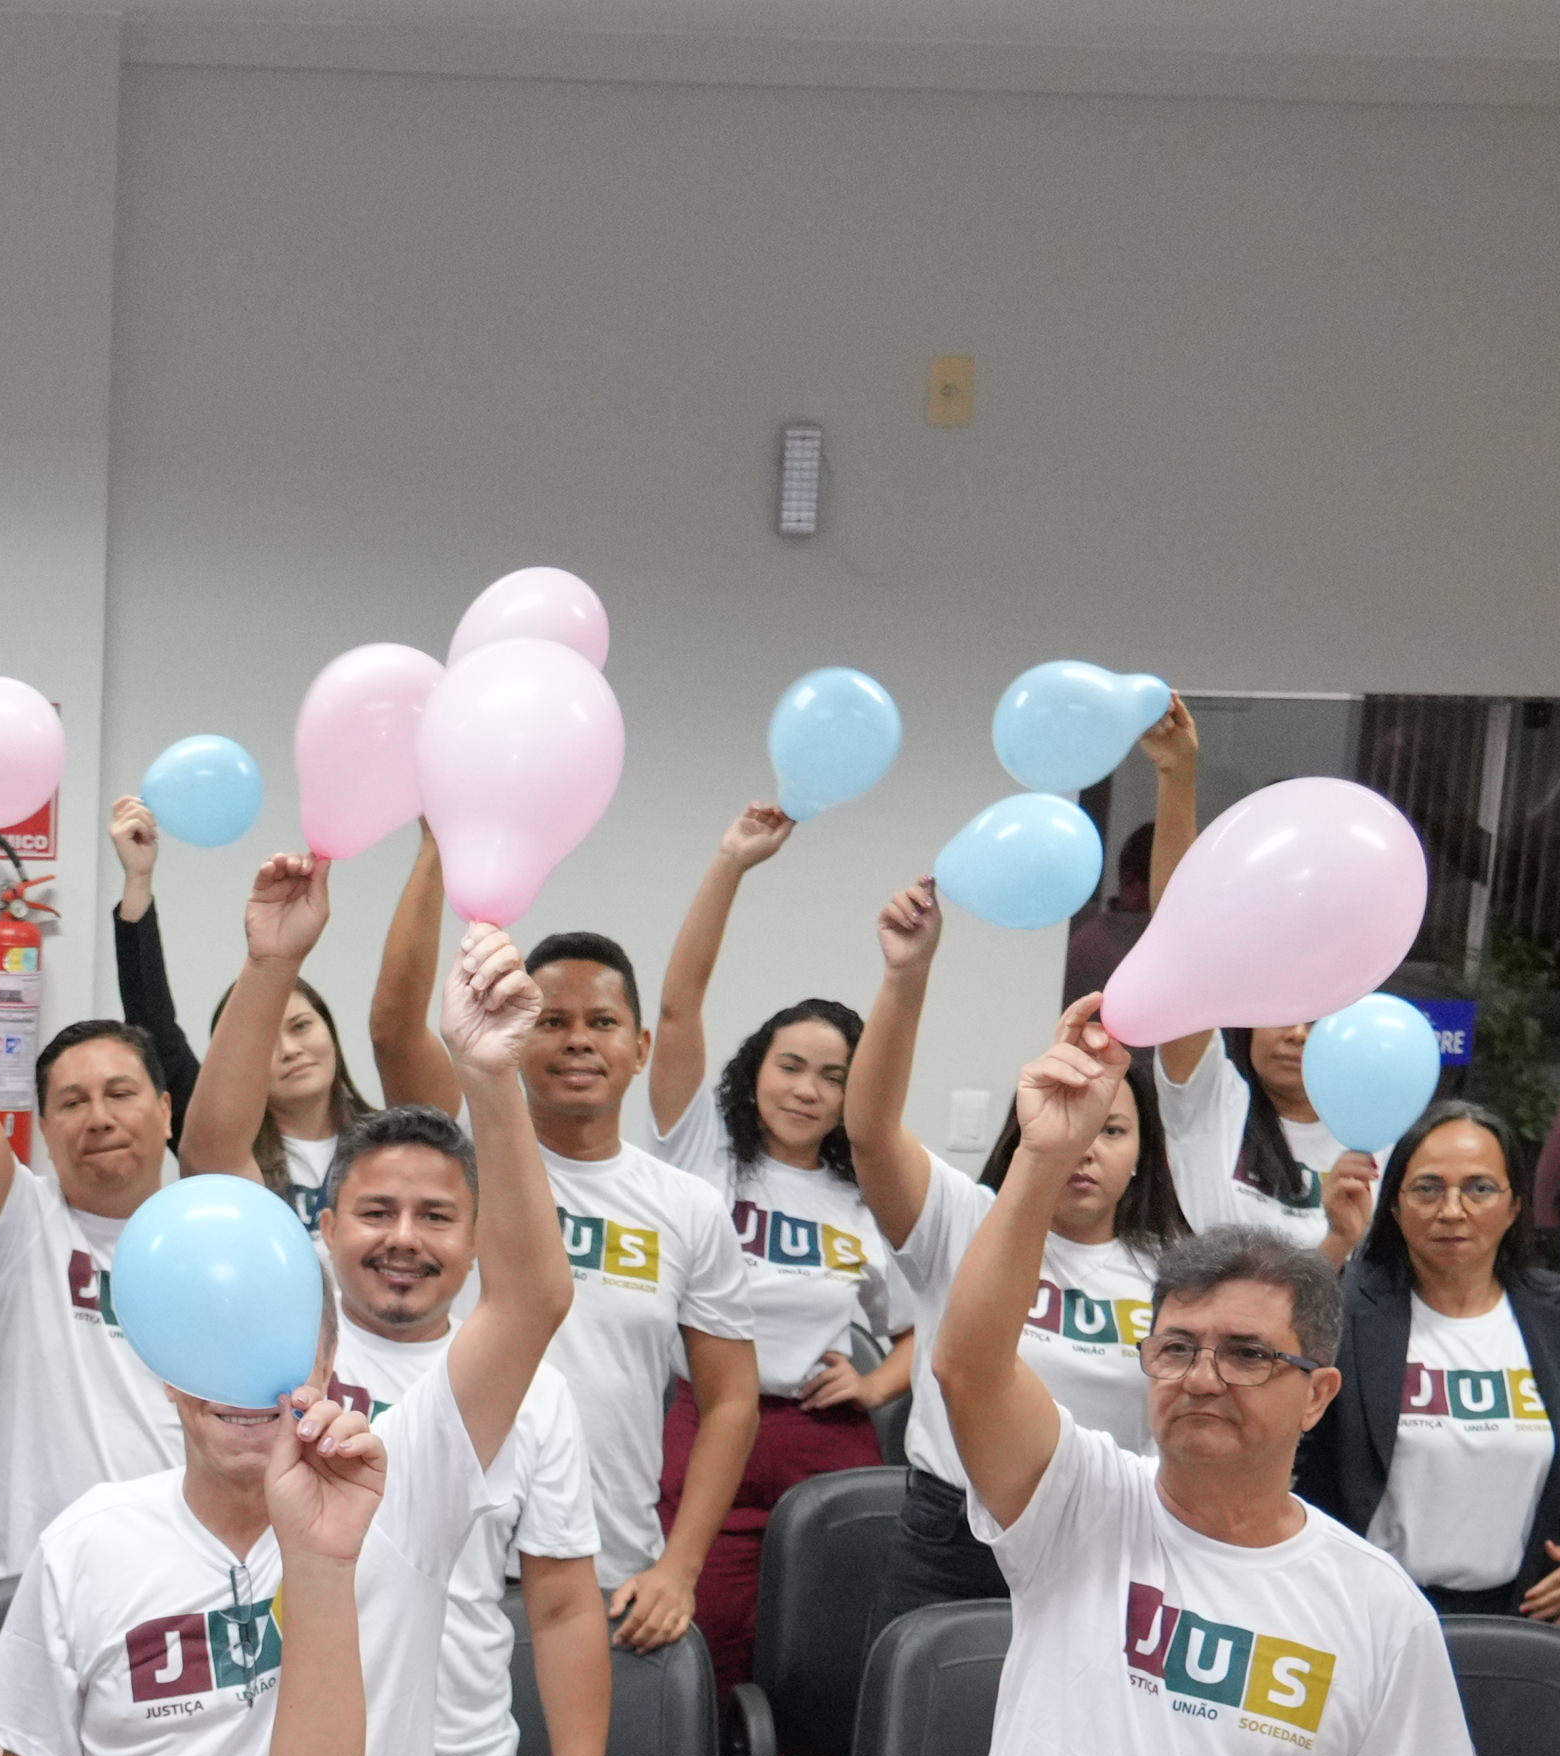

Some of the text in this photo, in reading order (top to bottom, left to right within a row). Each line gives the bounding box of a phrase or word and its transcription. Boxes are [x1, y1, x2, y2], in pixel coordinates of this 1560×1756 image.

[563, 1217, 647, 1268] US
[738, 1209, 860, 1265] JUS
[1409, 1370, 1546, 1413] JUS
[1134, 1604, 1312, 1709] JUS
[145, 1700, 205, 1719] JUSTIÇA
[1172, 1700, 1219, 1721] UNIÃO
[1238, 1717, 1314, 1751] SOCIEDADE
